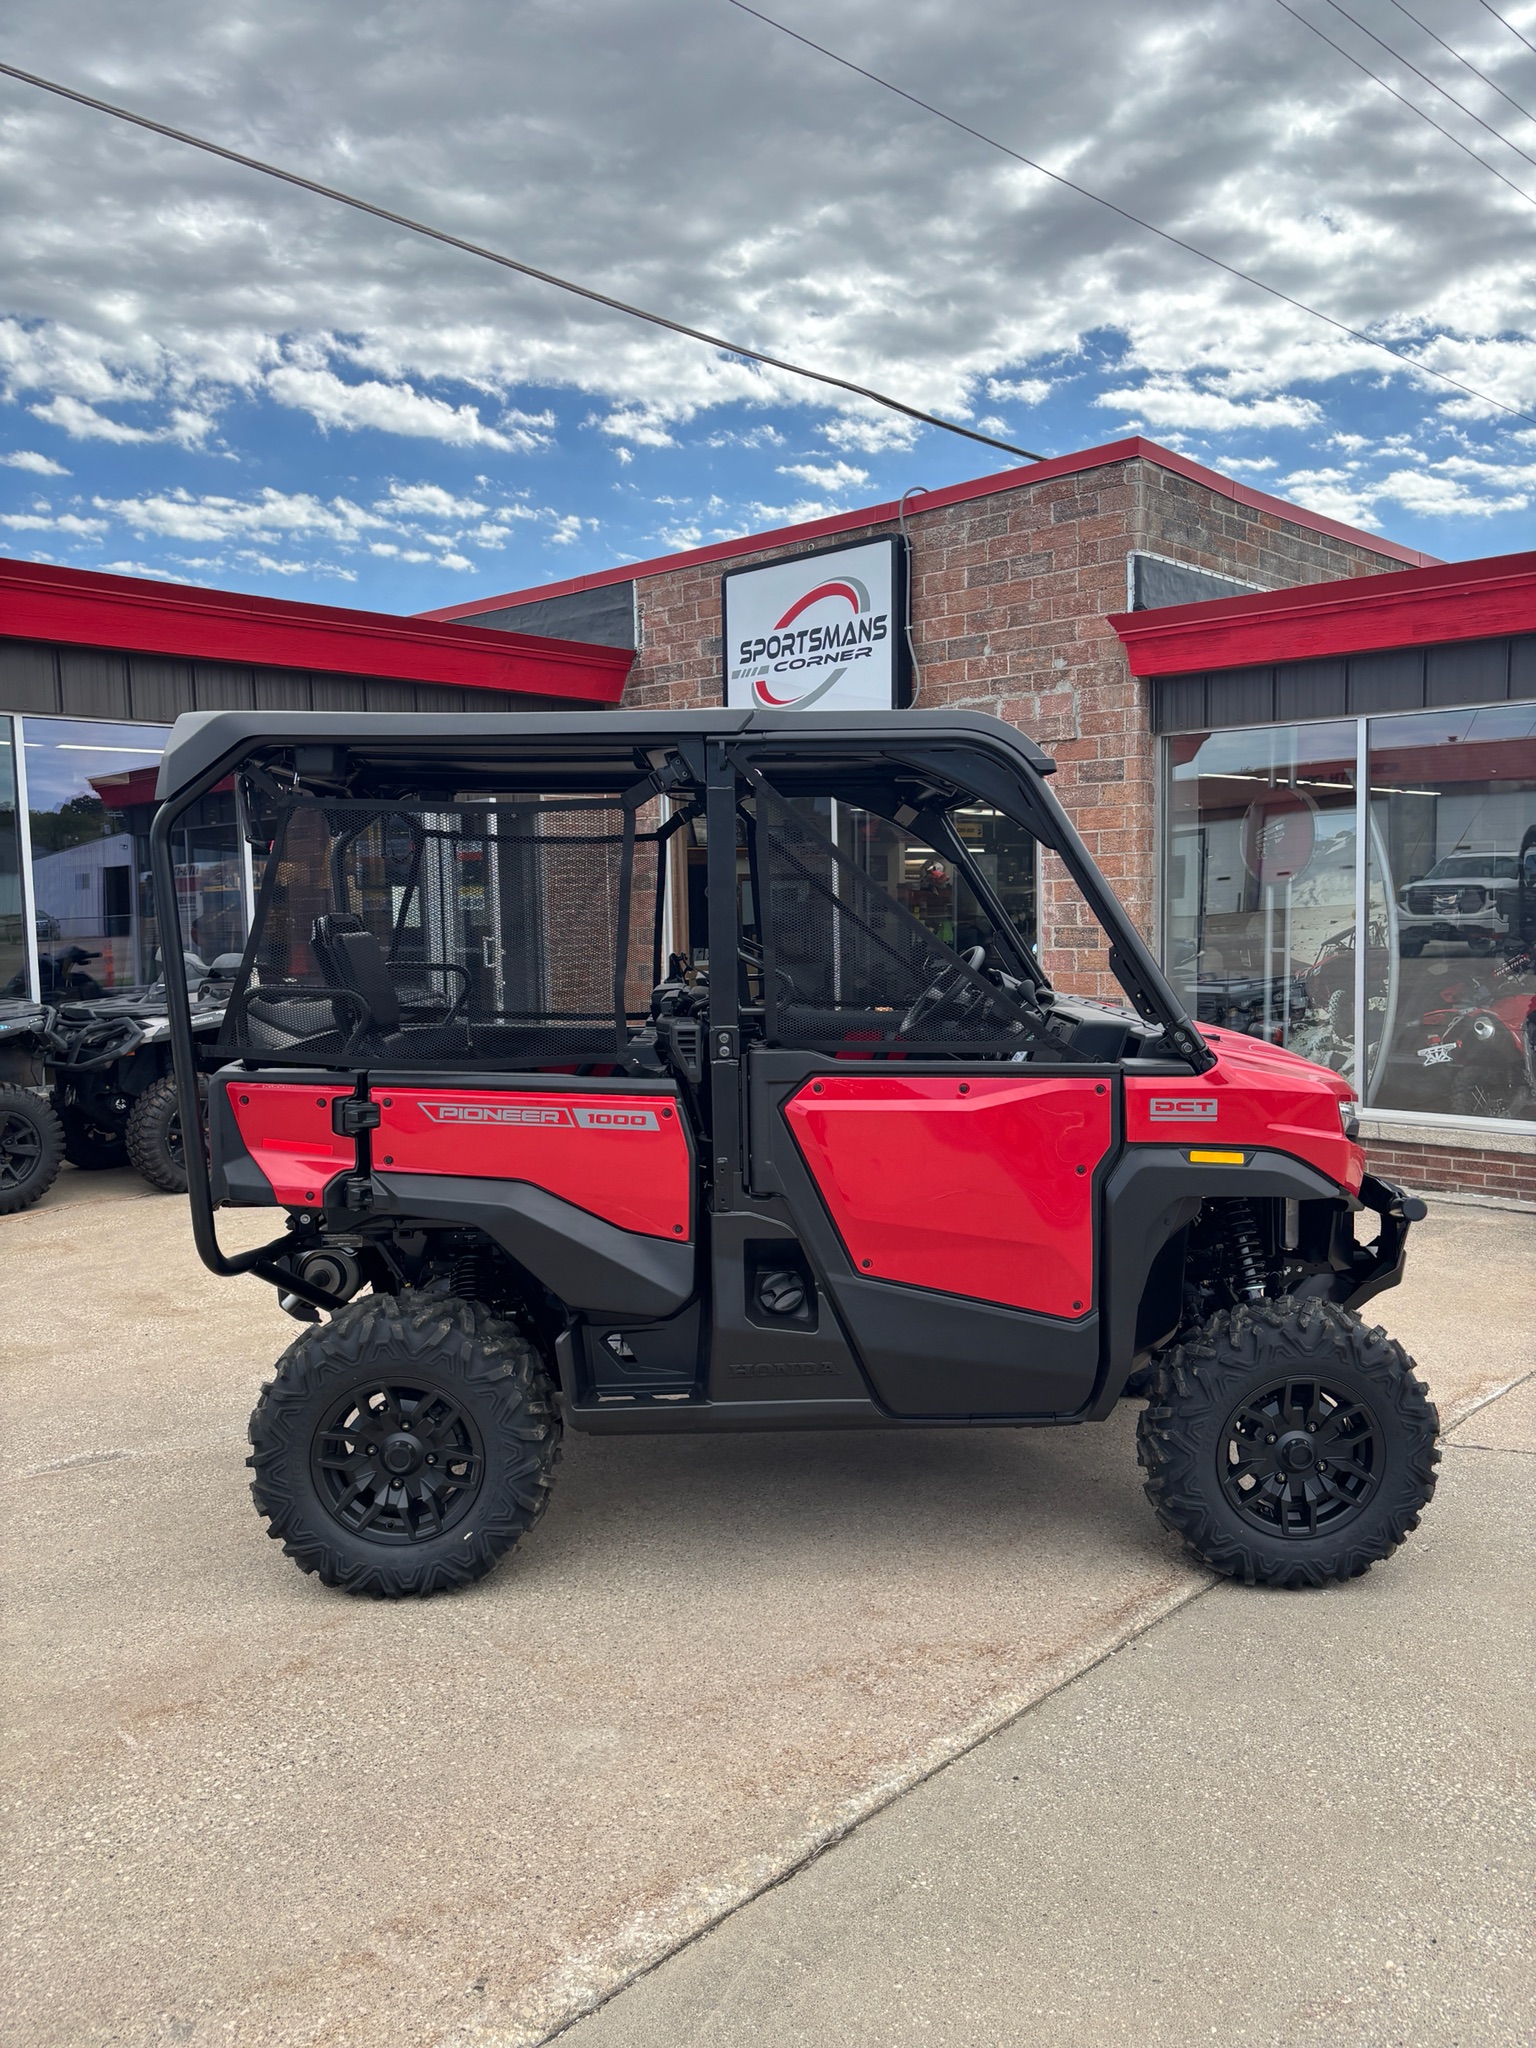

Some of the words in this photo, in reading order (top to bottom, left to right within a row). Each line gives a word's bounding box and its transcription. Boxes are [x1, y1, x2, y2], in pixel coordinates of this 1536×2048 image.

[739, 613, 888, 665] SPORTSMANS
[773, 646, 873, 673] CORNER
[1154, 1101, 1214, 1112] DCT
[439, 1107, 560, 1124] PIONEER
[587, 1112, 647, 1126] 1000
[728, 1361, 842, 1379] HONDA
